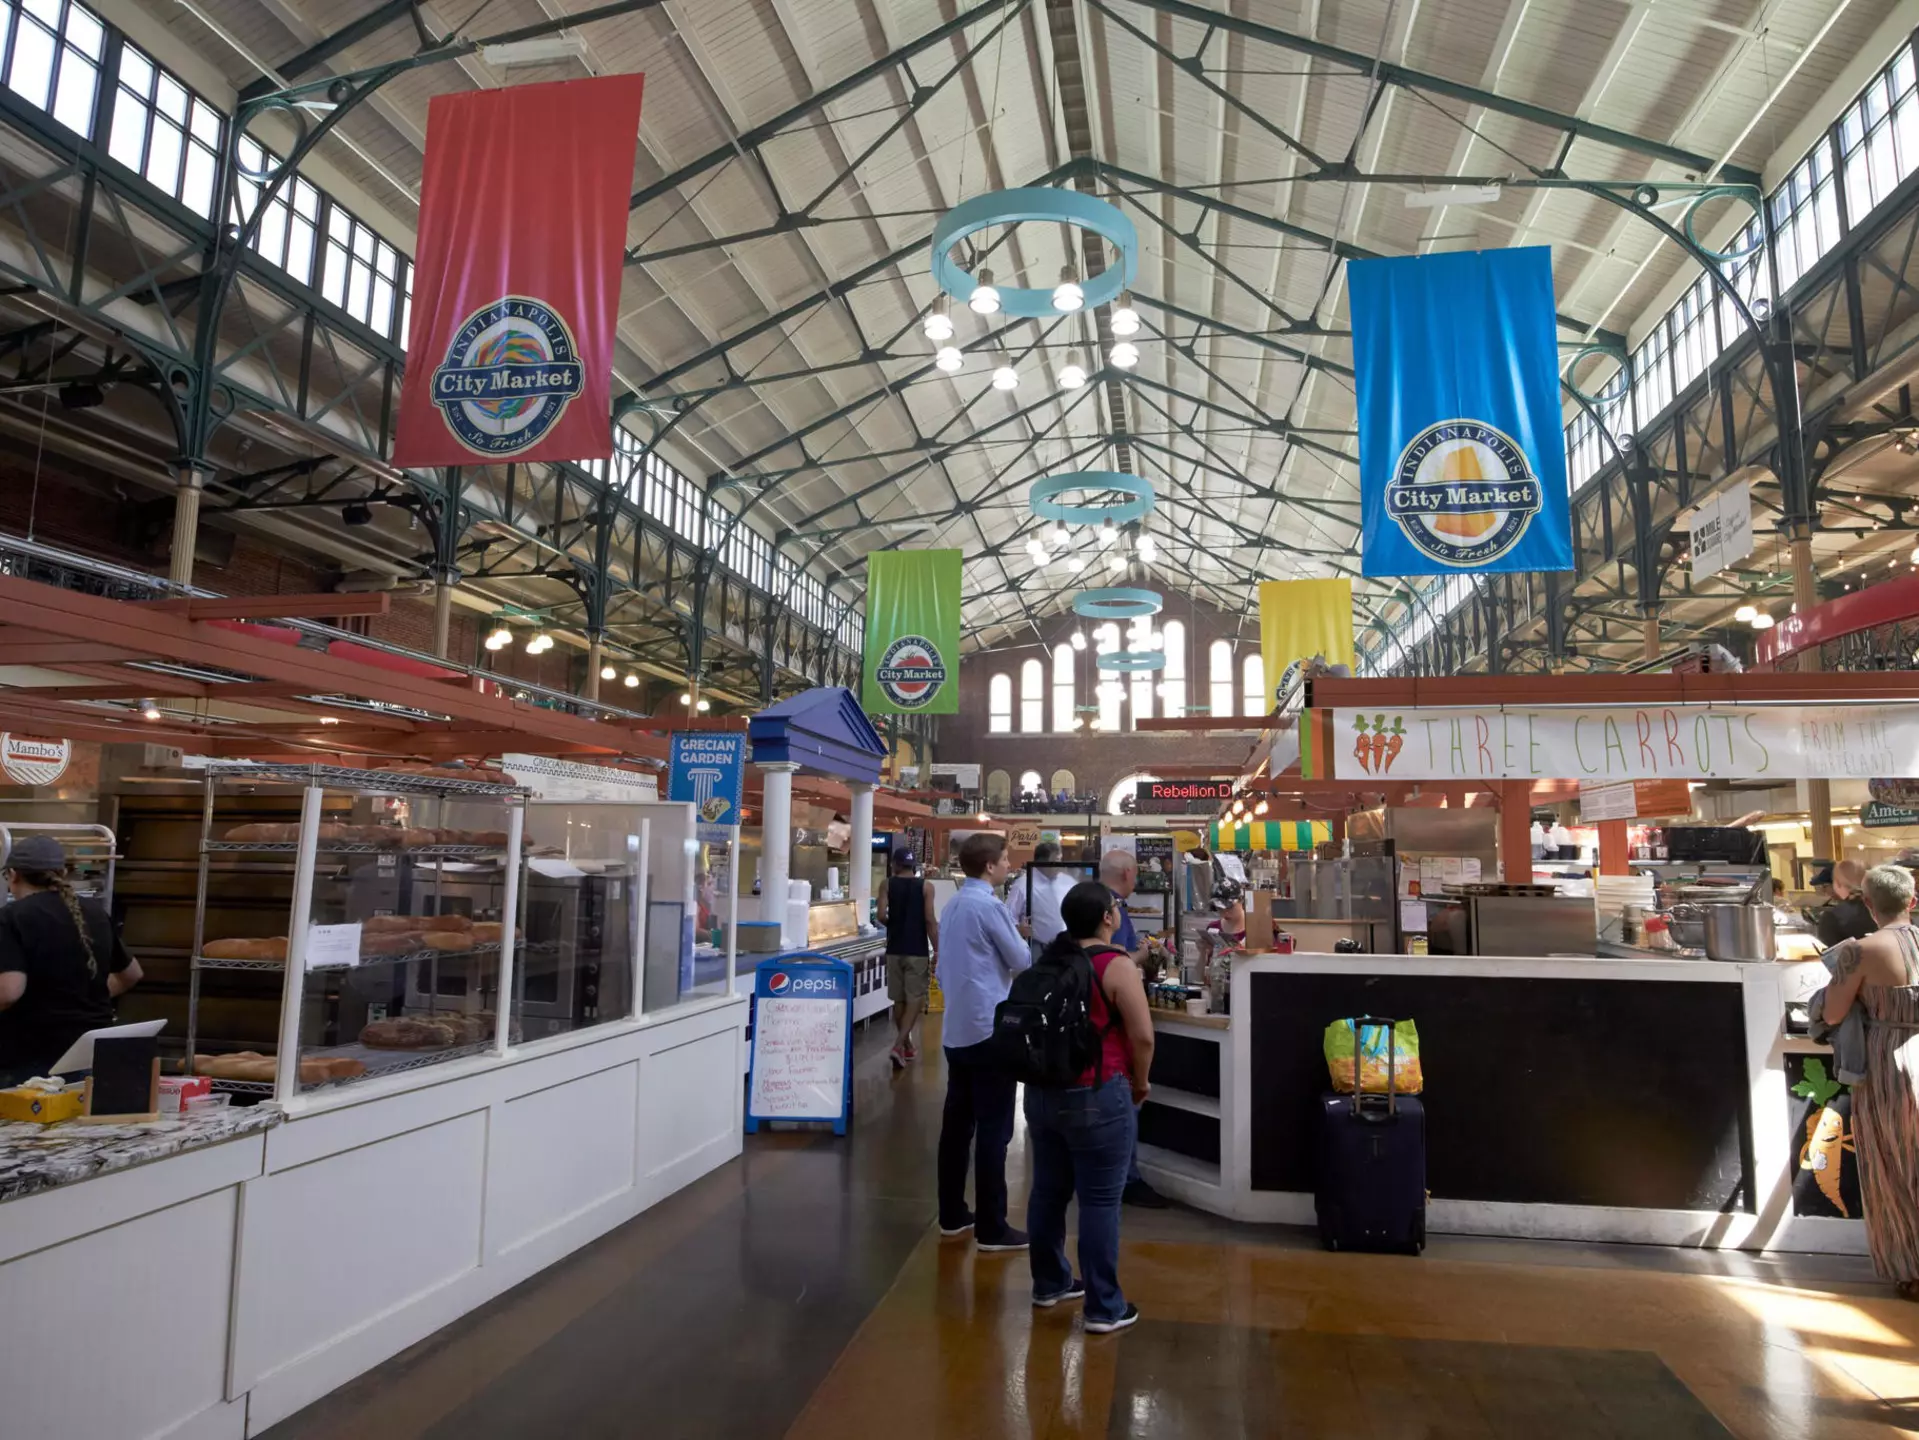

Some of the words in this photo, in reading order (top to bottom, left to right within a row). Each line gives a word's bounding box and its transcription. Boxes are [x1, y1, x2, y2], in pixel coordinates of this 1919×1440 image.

[452, 304, 567, 360] INDIANAPOLIS
[440, 374, 488, 395] City
[490, 369, 572, 390] Market
[469, 432, 484, 445] So
[490, 429, 533, 448] Fresh
[1403, 428, 1522, 478] INDIANAPOLIS
[1393, 489, 1443, 509] City
[1447, 486, 1532, 505] Market
[1431, 543, 1448, 555] So
[1454, 541, 1497, 558] Fresh
[880, 670, 902, 681] City
[903, 669, 943, 679] Market
[8, 740, 63, 757] Mambo's
[680, 739, 736, 751] GRECIAN
[1420, 713, 1542, 774] THREE
[1574, 709, 1769, 774] CARROTS
[680, 752, 732, 764] GARDEN
[1152, 784, 1215, 798] Rebellion
[793, 977, 836, 993] pepsi
